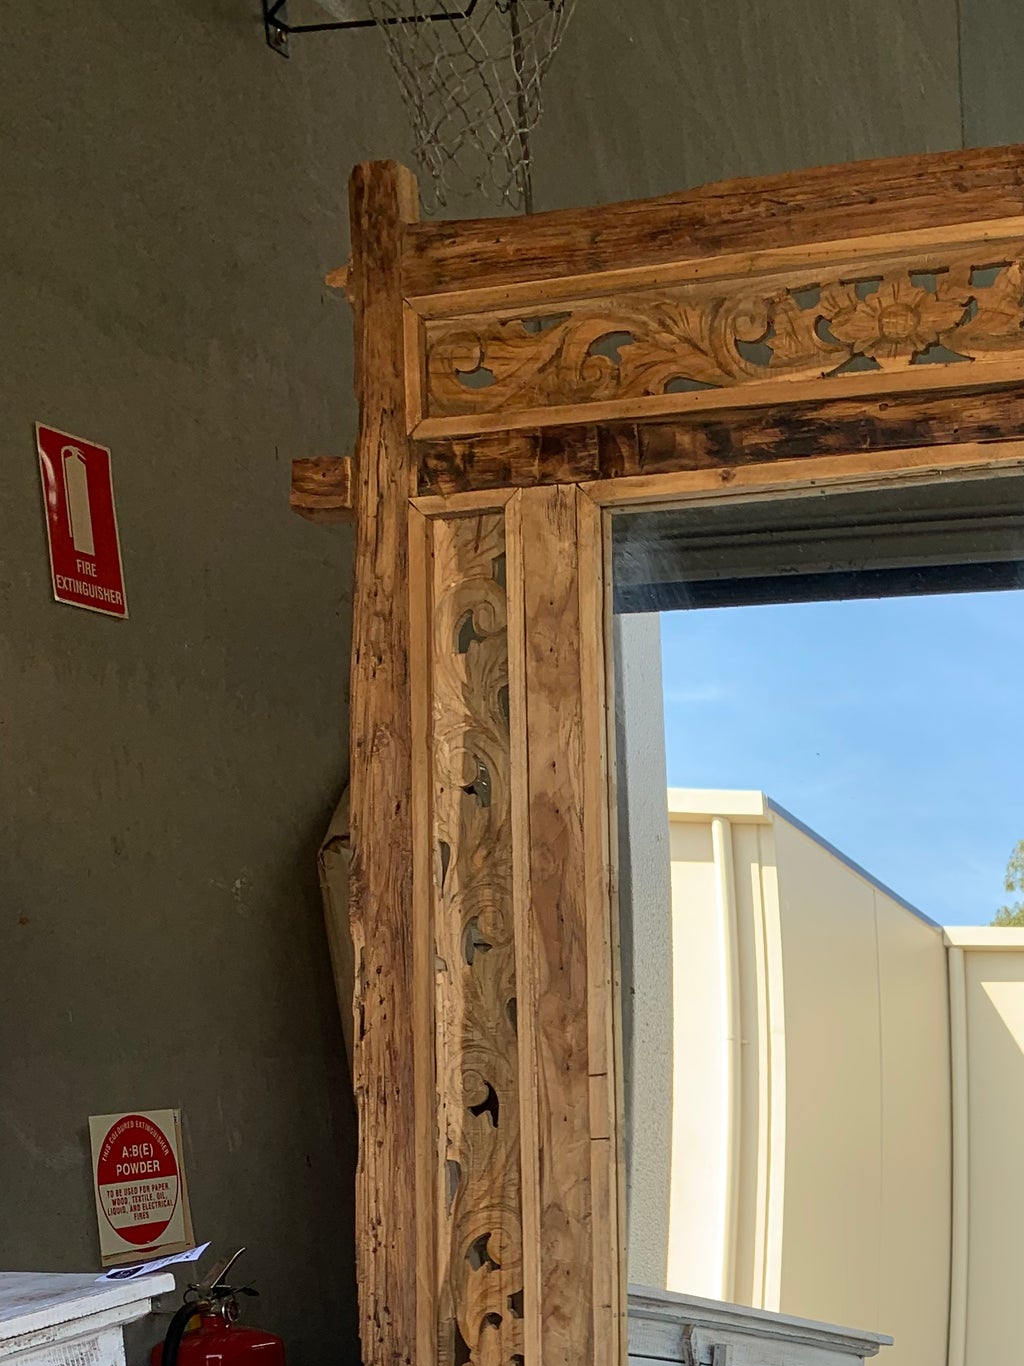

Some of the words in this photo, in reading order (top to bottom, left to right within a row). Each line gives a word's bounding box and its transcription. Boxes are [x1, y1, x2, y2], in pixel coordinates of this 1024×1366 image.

[76, 559, 98, 578] FIRE
[55, 574, 123, 606] EXTINGUISHER
[101, 1143, 112, 1162] THIS
[108, 1120, 135, 1144] COLOURED
[135, 1120, 170, 1156] EXTINGUISHER
[122, 1142, 154, 1159] A:B(E)
[116, 1159, 161, 1177] POWDER
[106, 1190, 114, 1198] TO
[115, 1188, 122, 1197] BE
[123, 1186, 138, 1196] USED
[139, 1184, 151, 1194] FOR
[129, 1203, 142, 1212] AND
[142, 1199, 174, 1211] ELECTRICAL
[133, 1211, 150, 1221] FIRES
